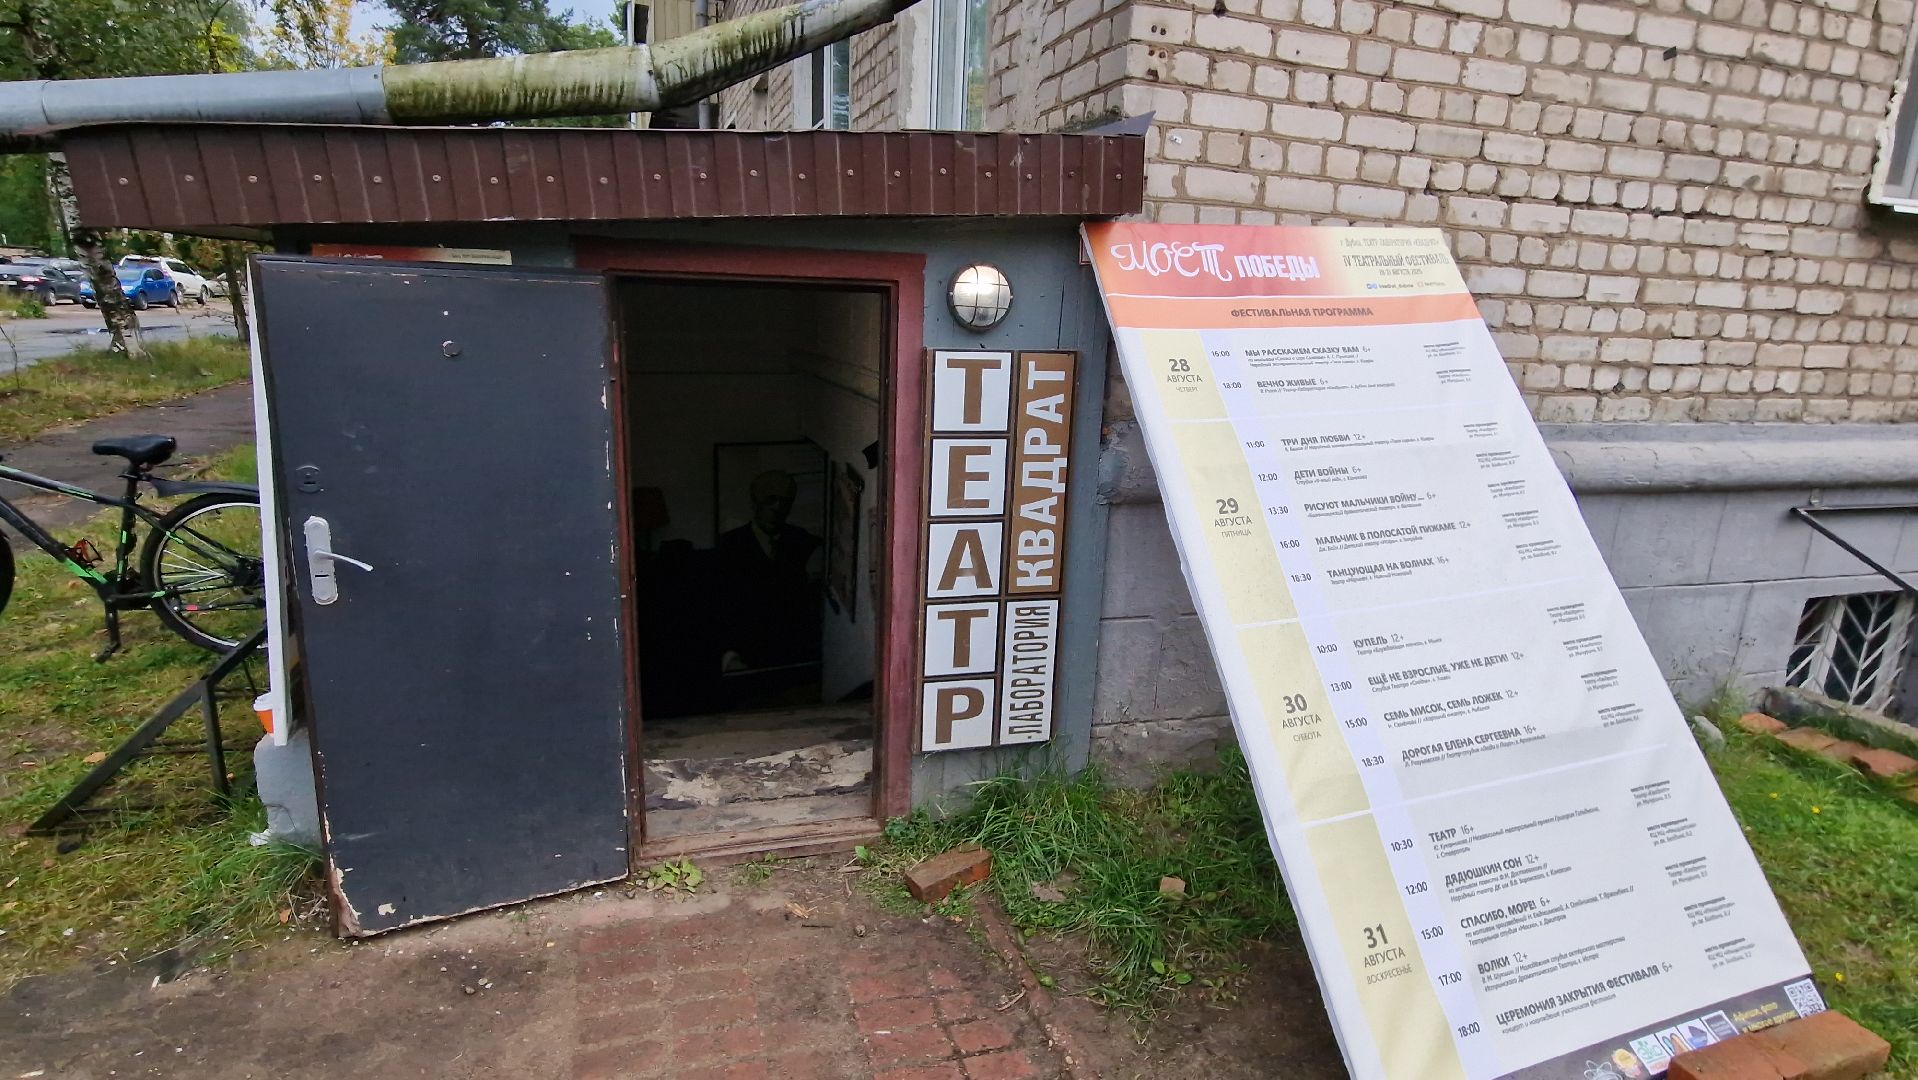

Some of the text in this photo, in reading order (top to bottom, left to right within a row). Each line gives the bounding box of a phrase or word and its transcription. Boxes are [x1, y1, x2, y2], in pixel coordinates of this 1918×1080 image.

[1352, 254, 1404, 266] ТЕАТРАЛЬНЫЙ
[1405, 253, 1450, 266] ФЕСТИВАЛЬ
[1235, 254, 1320, 281] ПОБЕДЫ
[1231, 306, 1373, 318] ФЕСТИВАЛЬНАЯ ПРОГРАММА
[1260, 347, 1311, 356] РАССКАЖЕМ
[1310, 346, 1341, 354] СКАЗКУ
[1167, 358, 1191, 372] 28
[1165, 374, 1202, 383] АВГУСТА
[1256, 380, 1285, 388] ВЕЧНО
[1285, 378, 1317, 386] ЖИВЫЕ
[1245, 440, 1265, 448] 11:00
[1280, 438, 1300, 446] ТРИ
[1299, 436, 1319, 445] ДНЯ
[1318, 434, 1351, 443] ЛЮБВИ
[1017, 361, 1067, 586] КВАДРАТ
[1257, 473, 1278, 481] 12:00
[1292, 469, 1317, 479] ДЕТИ
[1315, 465, 1349, 476] ВОЙНЫ
[1214, 497, 1241, 514] 29
[1267, 506, 1289, 515] 13:30
[1303, 501, 1340, 511] РИСУЮТ
[1340, 496, 1389, 508] МАЛЬЧИКИ
[1212, 515, 1252, 527] АВГУСТА
[1221, 529, 1251, 538] ПЯТНИЦА
[1314, 533, 1359, 545] МАЛЬЧИК
[1358, 532, 1366, 540] В
[1364, 524, 1419, 539] ПОЛОСАТОЙ
[1417, 522, 1457, 533] ПИЖАМЕ
[1279, 539, 1301, 549] 16:00
[1326, 563, 1385, 579] ТАНЦУЮЩАЯ
[1384, 562, 1399, 570] НА
[1398, 557, 1434, 568] ВОЛНАХ
[1290, 573, 1312, 582] 18:30
[1352, 633, 1405, 648] КУПЕЛЬ 12+
[1316, 644, 1338, 654] 10:00
[1366, 672, 1389, 687] ЕЩЁ
[1388, 672, 1402, 682] НЕ
[1401, 663, 1451, 681] ВЗРОСЛЫЕ,
[1450, 660, 1470, 671] УЖЕ
[1470, 658, 1483, 668] НЕ
[1482, 654, 1510, 666] ДЕТИ!
[1330, 680, 1353, 692] 13:00
[1281, 692, 1309, 714] 30
[1382, 688, 1520, 721] СЕМЬ МИСОК, СЕМЬ ЛОЖЕК 12+
[1280, 713, 1322, 729] АВГУСТА
[1344, 716, 1368, 729] 15:00
[1399, 724, 1538, 761] ДОРОГАЯ ЕЛЕНА СЕРГЕЕВНА 16+
[1361, 755, 1385, 768] 18:30
[1428, 823, 1475, 842] ТЕАТР 16+
[1389, 838, 1414, 852] 10:30
[1443, 852, 1540, 888] ДЯДЮШКИН СОН 12+
[1404, 881, 1429, 895] 12:00
[1459, 895, 1551, 931] СПАСИБО, МОРЕ! 6+
[1362, 923, 1388, 948] 31
[1420, 925, 1444, 941] 15:00
[1361, 946, 1406, 968] АВГУСТА
[1476, 950, 1529, 974] ВОЛКИ 12+
[1365, 963, 1412, 984] ВОСКРЕСЕНЬЕ
[1437, 970, 1463, 986] 17:00
[1495, 960, 1673, 1027] ЦЕРЕМОНИЯ ЗАКРЫТИЯ ФЕСТИВАЛЯ 6+
[1456, 1021, 1481, 1038] 18:00
